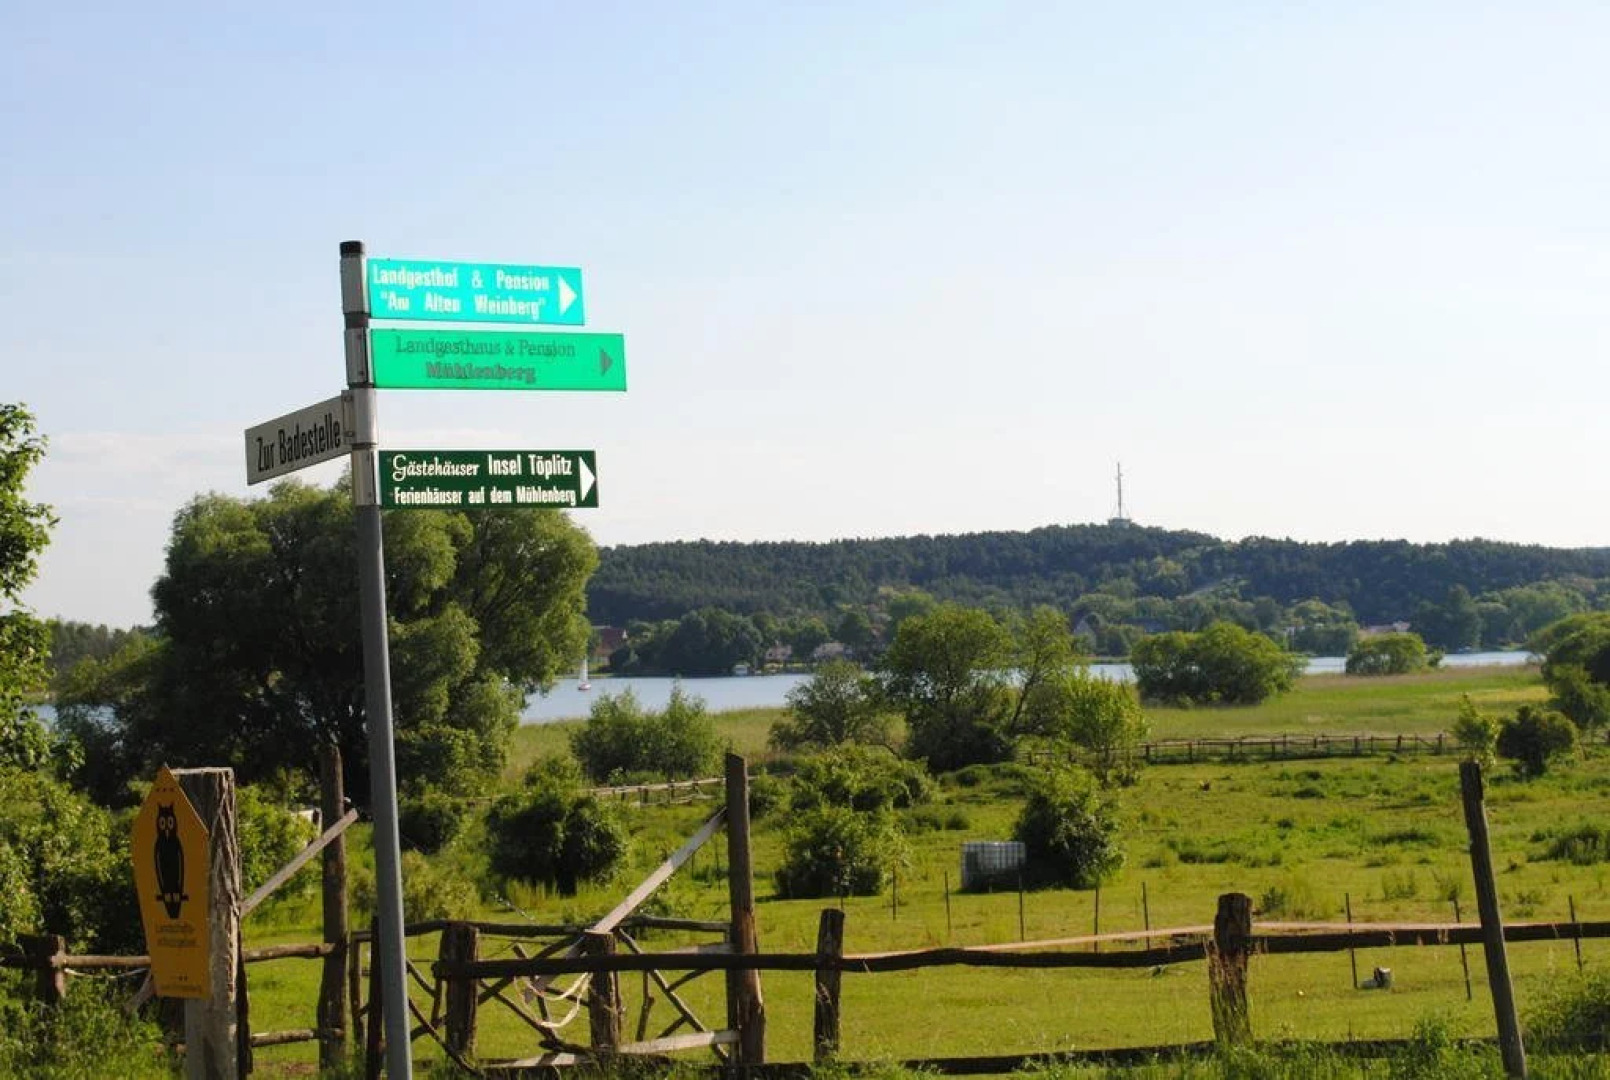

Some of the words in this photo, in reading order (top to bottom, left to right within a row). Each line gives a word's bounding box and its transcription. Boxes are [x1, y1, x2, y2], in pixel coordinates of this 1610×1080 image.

[373, 264, 459, 289] Landgasthof
[471, 270, 483, 288] &
[496, 270, 549, 291] Pension
[425, 292, 461, 312] Alten
[395, 336, 501, 358] Landgasthaus
[505, 342, 514, 354] &
[518, 340, 576, 359] Pension
[425, 361, 537, 384] Mühlenberg
[256, 436, 275, 473] Zur
[278, 412, 341, 465] Badestelle
[392, 454, 480, 482] Gästehäuser
[487, 454, 523, 476] Insel
[528, 455, 573, 480] Töplitz
[394, 486, 463, 504] Ferienhäuser
[468, 486, 485, 504] auf
[490, 486, 512, 504] dem
[516, 486, 577, 507] Mühlenberg
